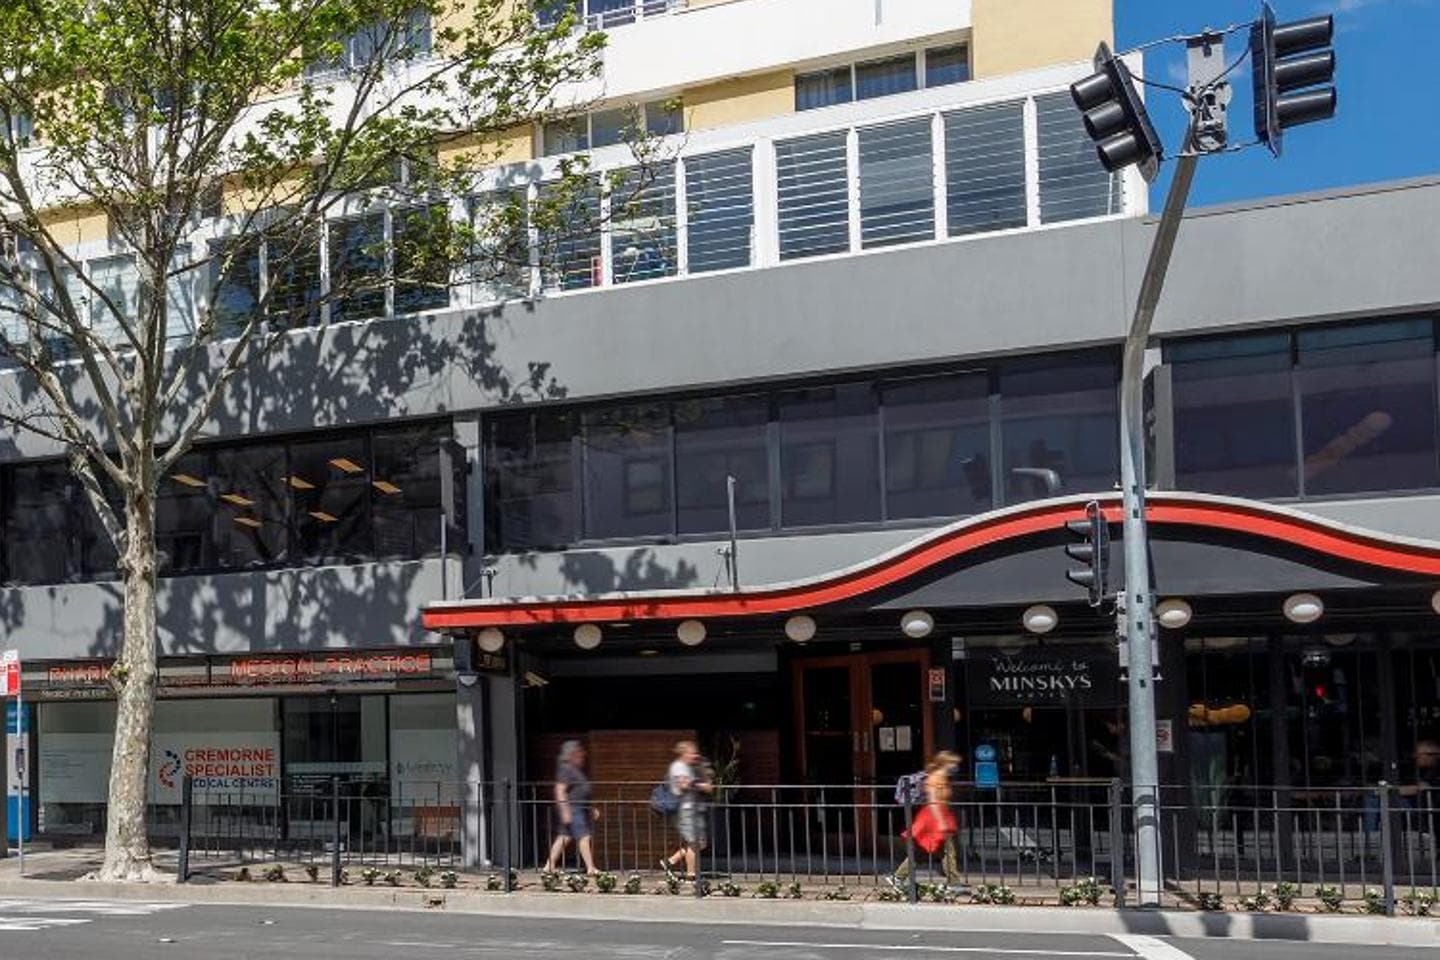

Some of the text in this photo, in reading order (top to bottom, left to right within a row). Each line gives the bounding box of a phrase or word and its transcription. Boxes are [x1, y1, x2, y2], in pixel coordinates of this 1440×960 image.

[232, 654, 431, 678] MEDICAL PRACTICE
[992, 656, 1089, 673] Welcome to
[990, 674, 1092, 691] MINSKYS
[184, 763, 273, 777] SPECIALIST
[192, 778, 229, 789] EDICAL
